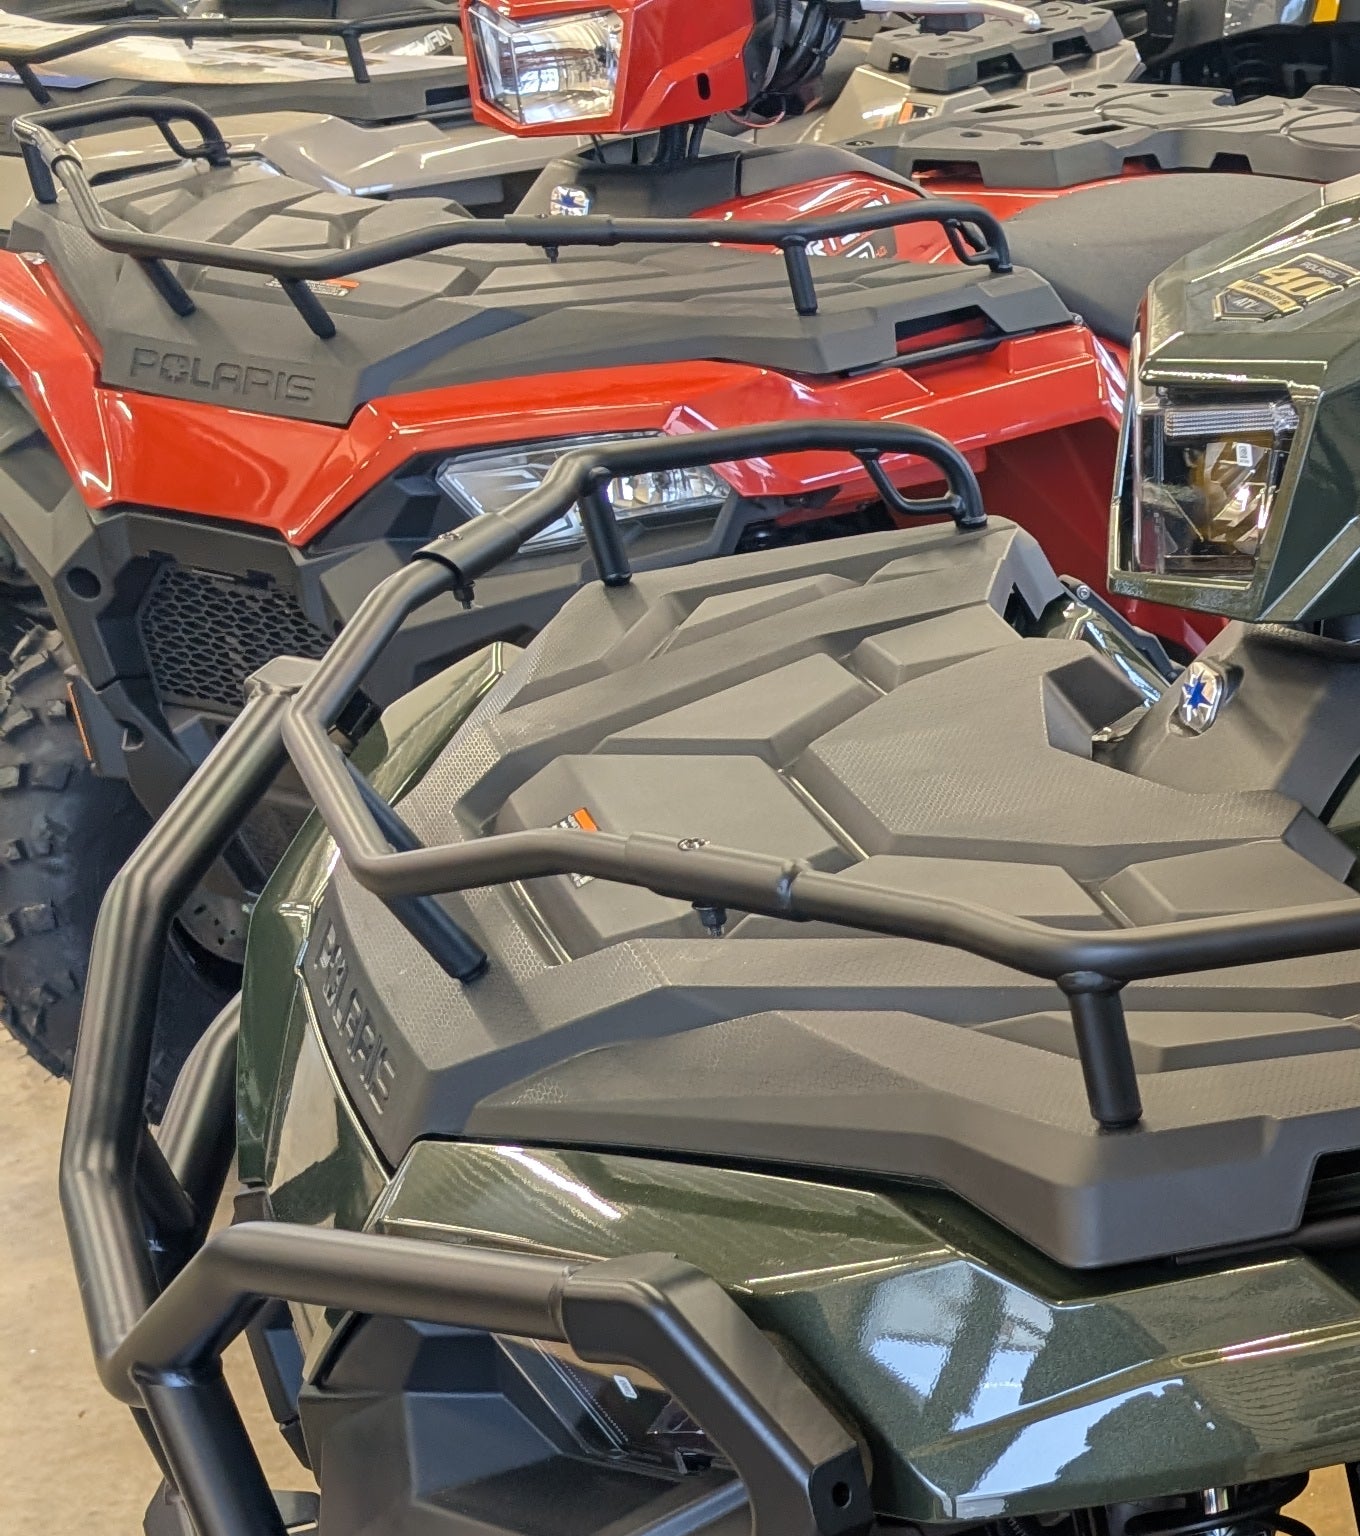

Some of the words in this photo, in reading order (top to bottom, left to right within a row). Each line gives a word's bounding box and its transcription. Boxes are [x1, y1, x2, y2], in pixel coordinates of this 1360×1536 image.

[1259, 267, 1335, 297] 40
[129, 347, 317, 402] POLARIS
[314, 917, 397, 1116] POLARIS
